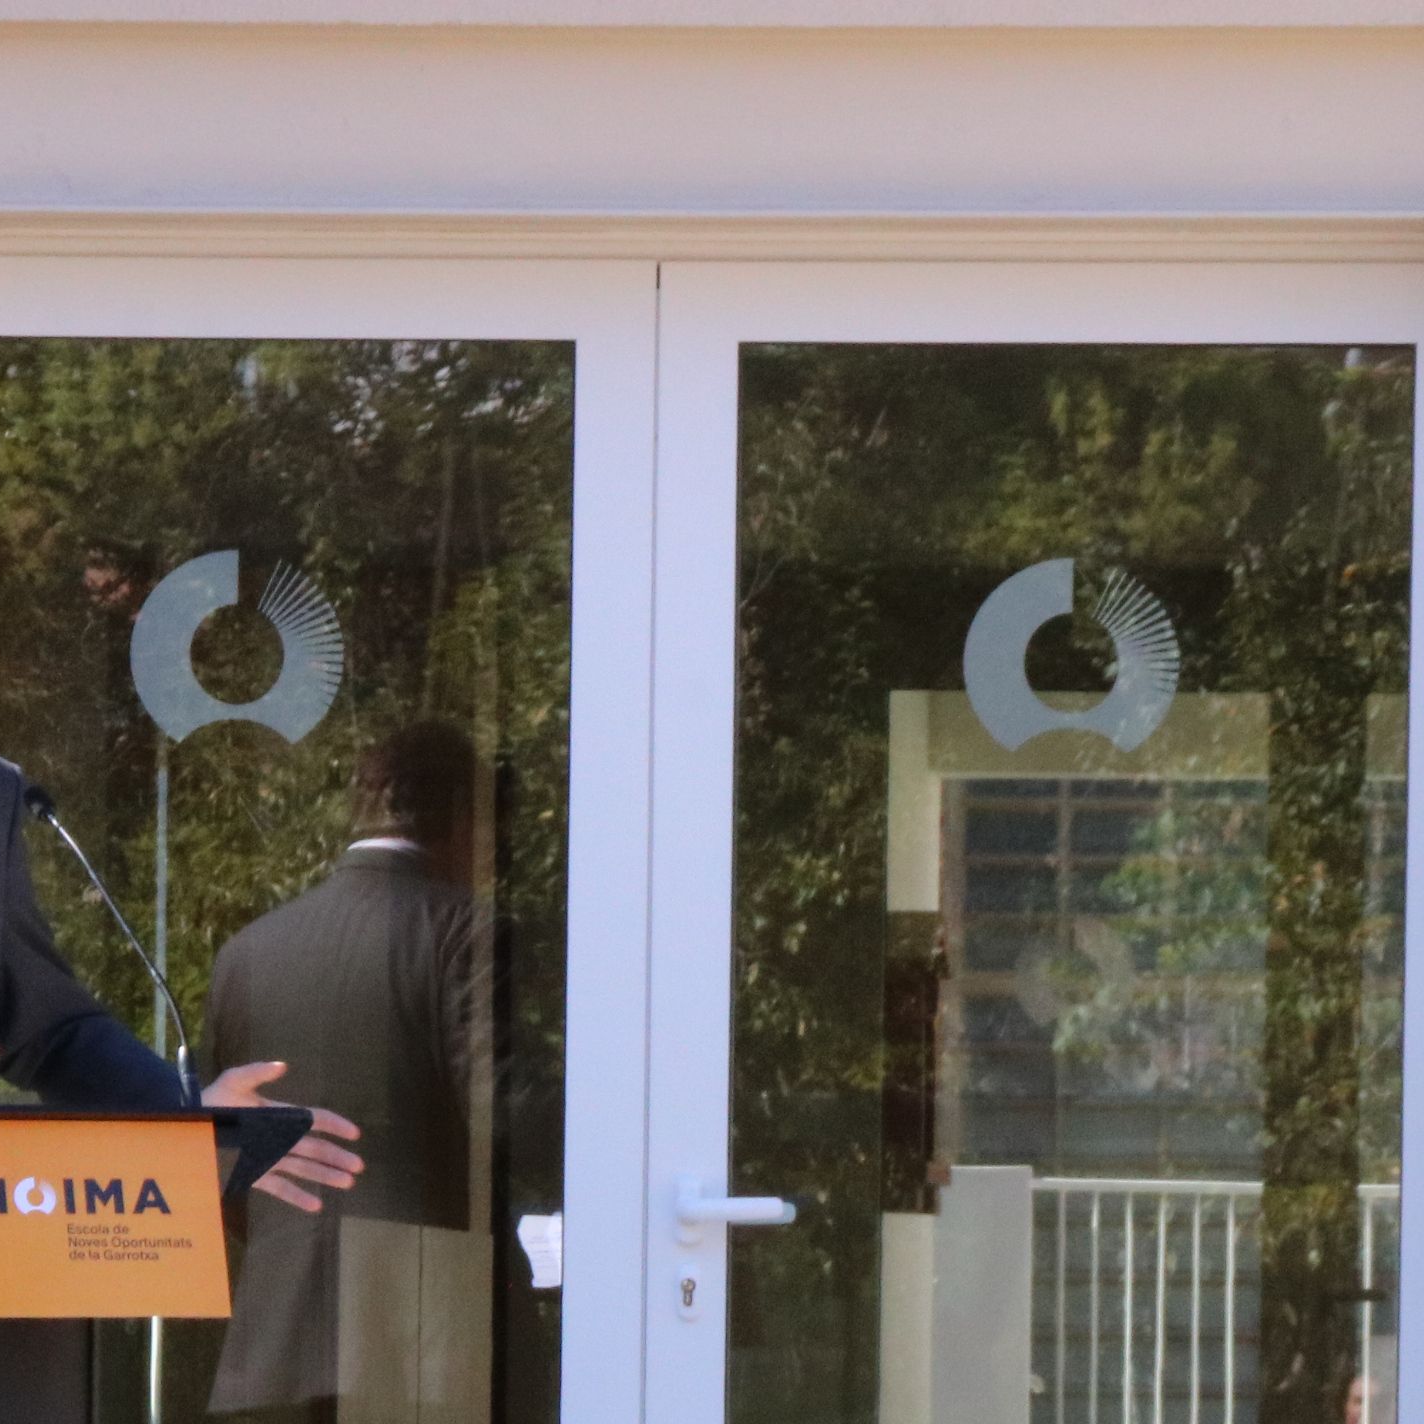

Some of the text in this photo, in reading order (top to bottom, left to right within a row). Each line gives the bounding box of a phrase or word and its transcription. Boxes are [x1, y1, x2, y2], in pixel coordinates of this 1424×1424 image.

[67, 1223, 129, 1235] Escola de
[68, 1236, 193, 1250] Noves Oportunitats
[68, 1249, 160, 1261] de la Garrotxa
